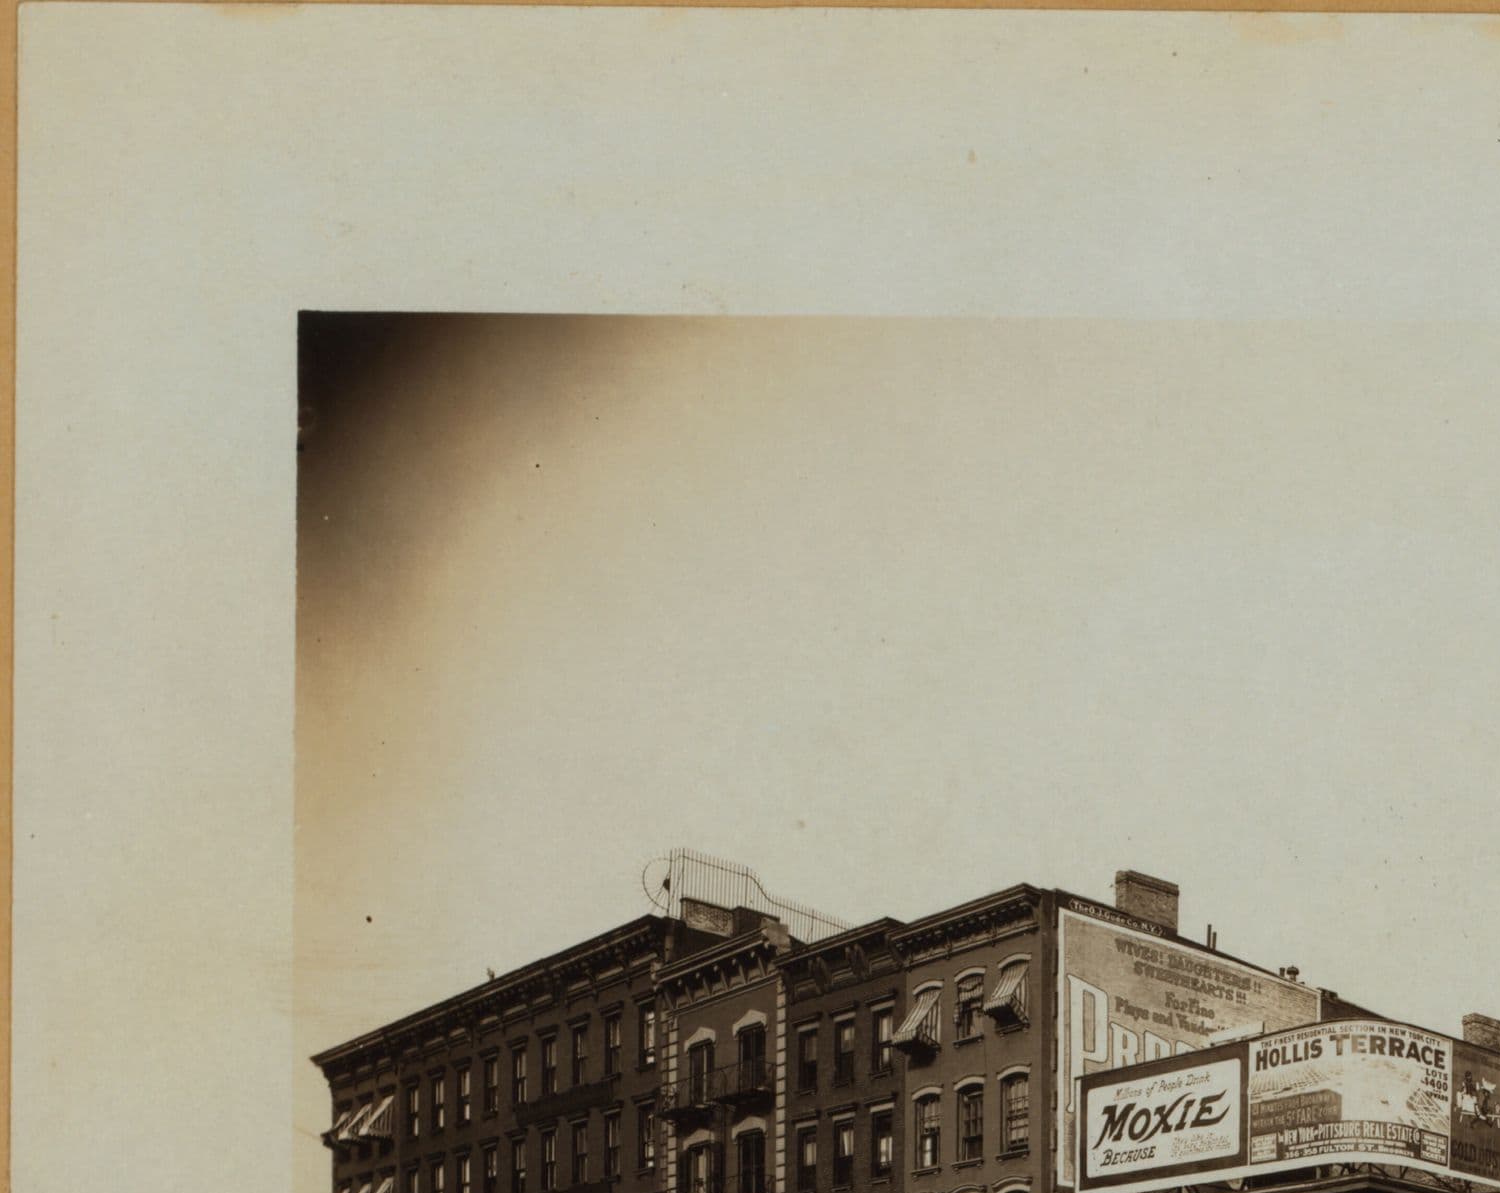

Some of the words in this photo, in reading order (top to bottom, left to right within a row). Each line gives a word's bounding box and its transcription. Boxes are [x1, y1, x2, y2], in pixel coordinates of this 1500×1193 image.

[1115, 996, 1149, 1021] Plays
[1152, 1012, 1173, 1027] and
[1261, 1040, 1273, 1048] THE
[1274, 1034, 1295, 1045] FINEST
[1296, 1027, 1336, 1040] RESIDENTIAL
[1339, 1023, 1375, 1033] SECTION
[1378, 1026, 1387, 1034] IN
[1389, 1028, 1407, 1037] NEW
[1408, 1030, 1424, 1042] YORK
[1425, 1036, 1441, 1047] CITY
[1255, 1038, 1323, 1072] HOLLIS
[1329, 1035, 1446, 1070] TERRACE
[1426, 1068, 1448, 1081] LOTS
[1092, 1089, 1230, 1150] MOXIE
[1363, 1121, 1385, 1139] REAL
[1386, 1123, 1413, 1143] ESTATE
[1100, 1146, 1157, 1167] BECAUSE
[1318, 1143, 1355, 1154] FULTON
